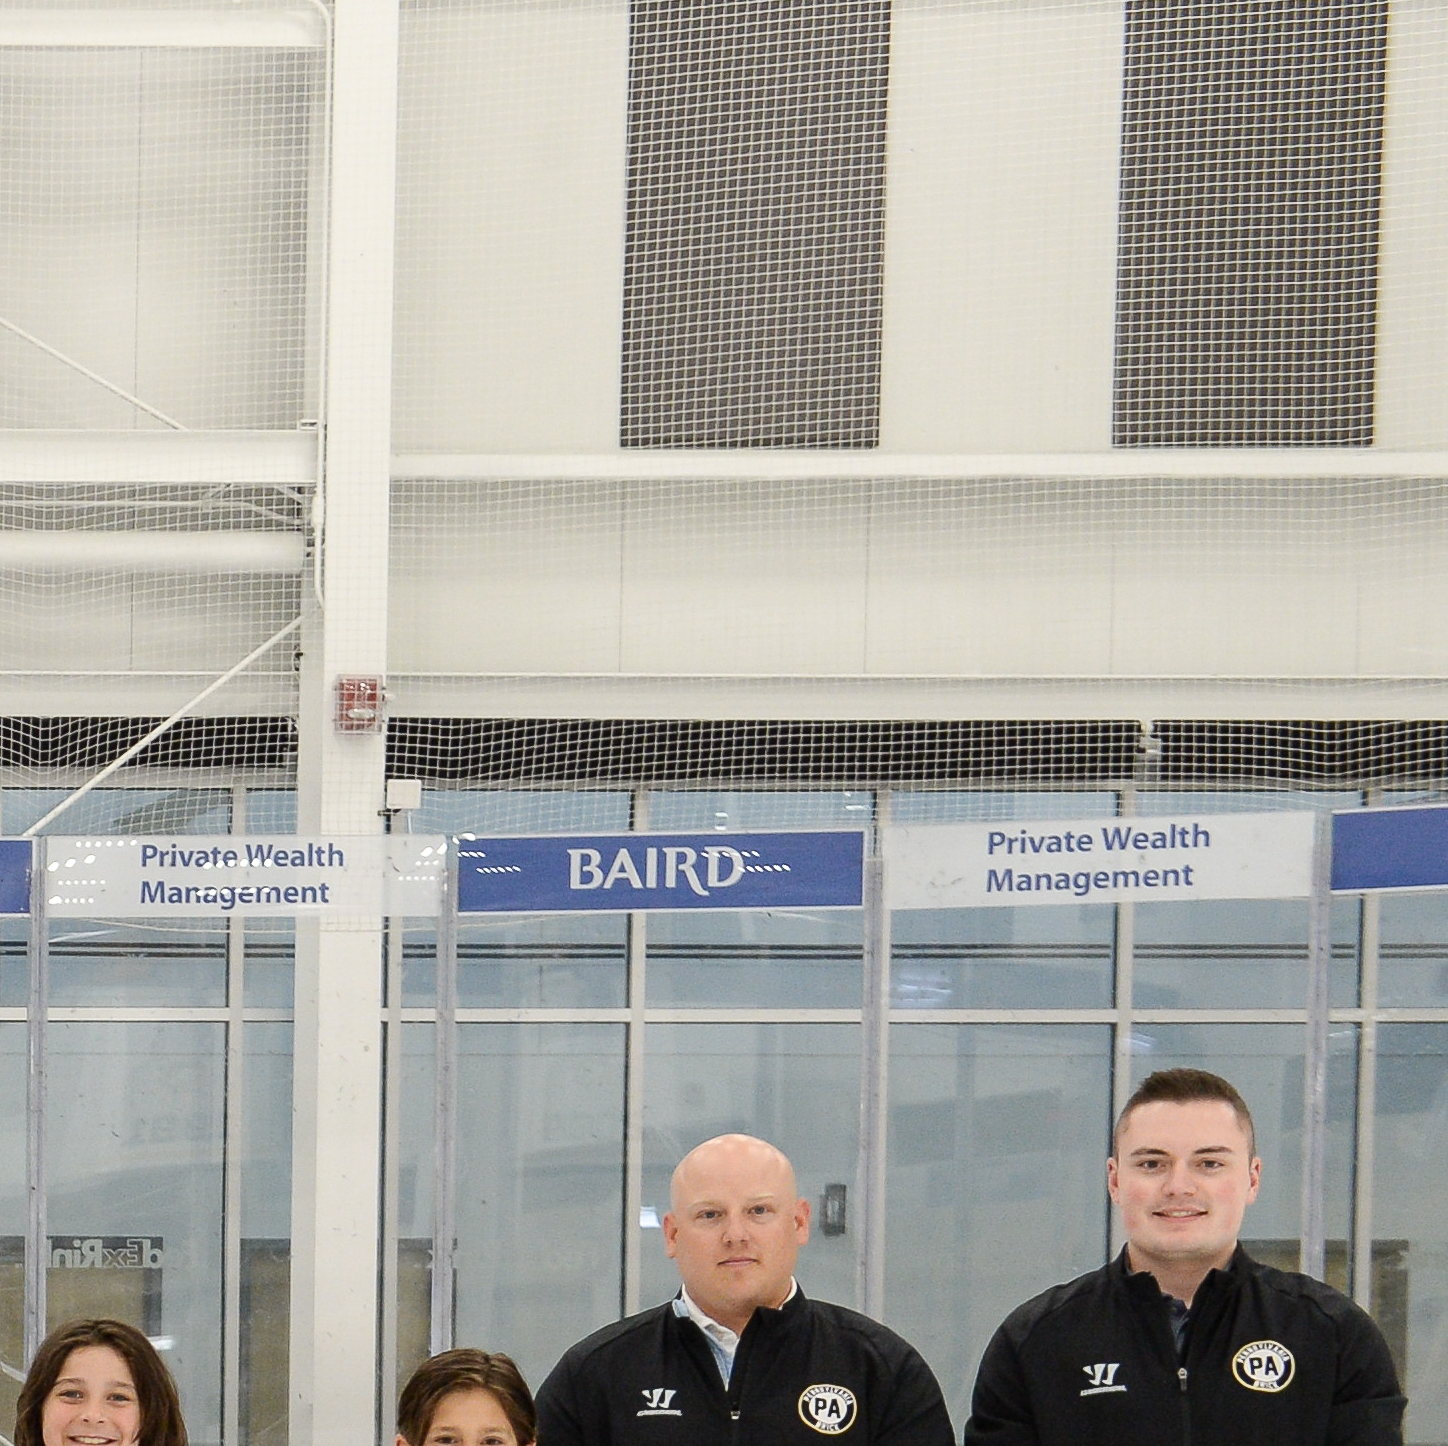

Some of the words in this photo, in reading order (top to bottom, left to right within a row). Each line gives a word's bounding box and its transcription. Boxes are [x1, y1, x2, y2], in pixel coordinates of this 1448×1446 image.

[987, 827, 1094, 856] Private
[1102, 822, 1211, 852] Wealth
[140, 843, 237, 869] Private
[245, 843, 345, 869] Wealth
[567, 846, 746, 896] BAIRD
[987, 862, 1195, 897] Management
[140, 881, 330, 909] Management
[1249, 1355, 1278, 1376] PA
[814, 1397, 841, 1419] PA
